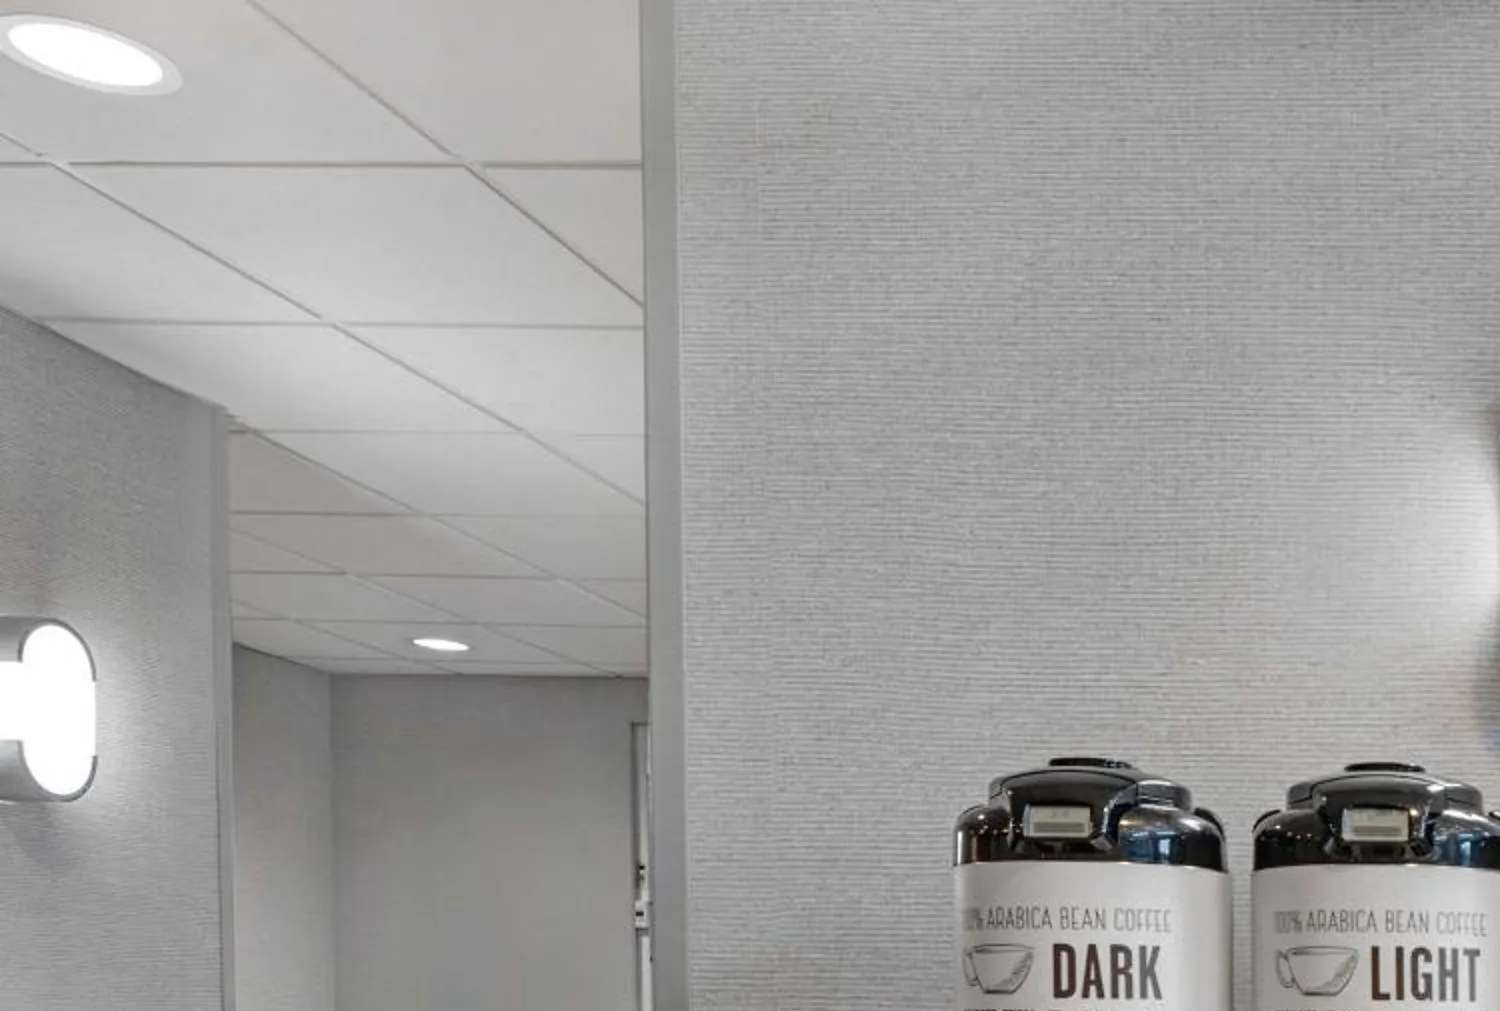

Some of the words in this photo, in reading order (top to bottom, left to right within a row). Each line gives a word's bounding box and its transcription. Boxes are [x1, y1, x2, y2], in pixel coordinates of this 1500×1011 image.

[987, 906, 1052, 930] ARABICA
[1060, 907, 1106, 930] BEAN
[1114, 908, 1172, 933] COFFEE
[1306, 909, 1377, 934] ARABICA
[1385, 909, 1429, 933] BEAN
[1436, 911, 1488, 937] COFFEE
[1052, 943, 1163, 1000] DARK
[1371, 946, 1480, 1001] LIGHT
